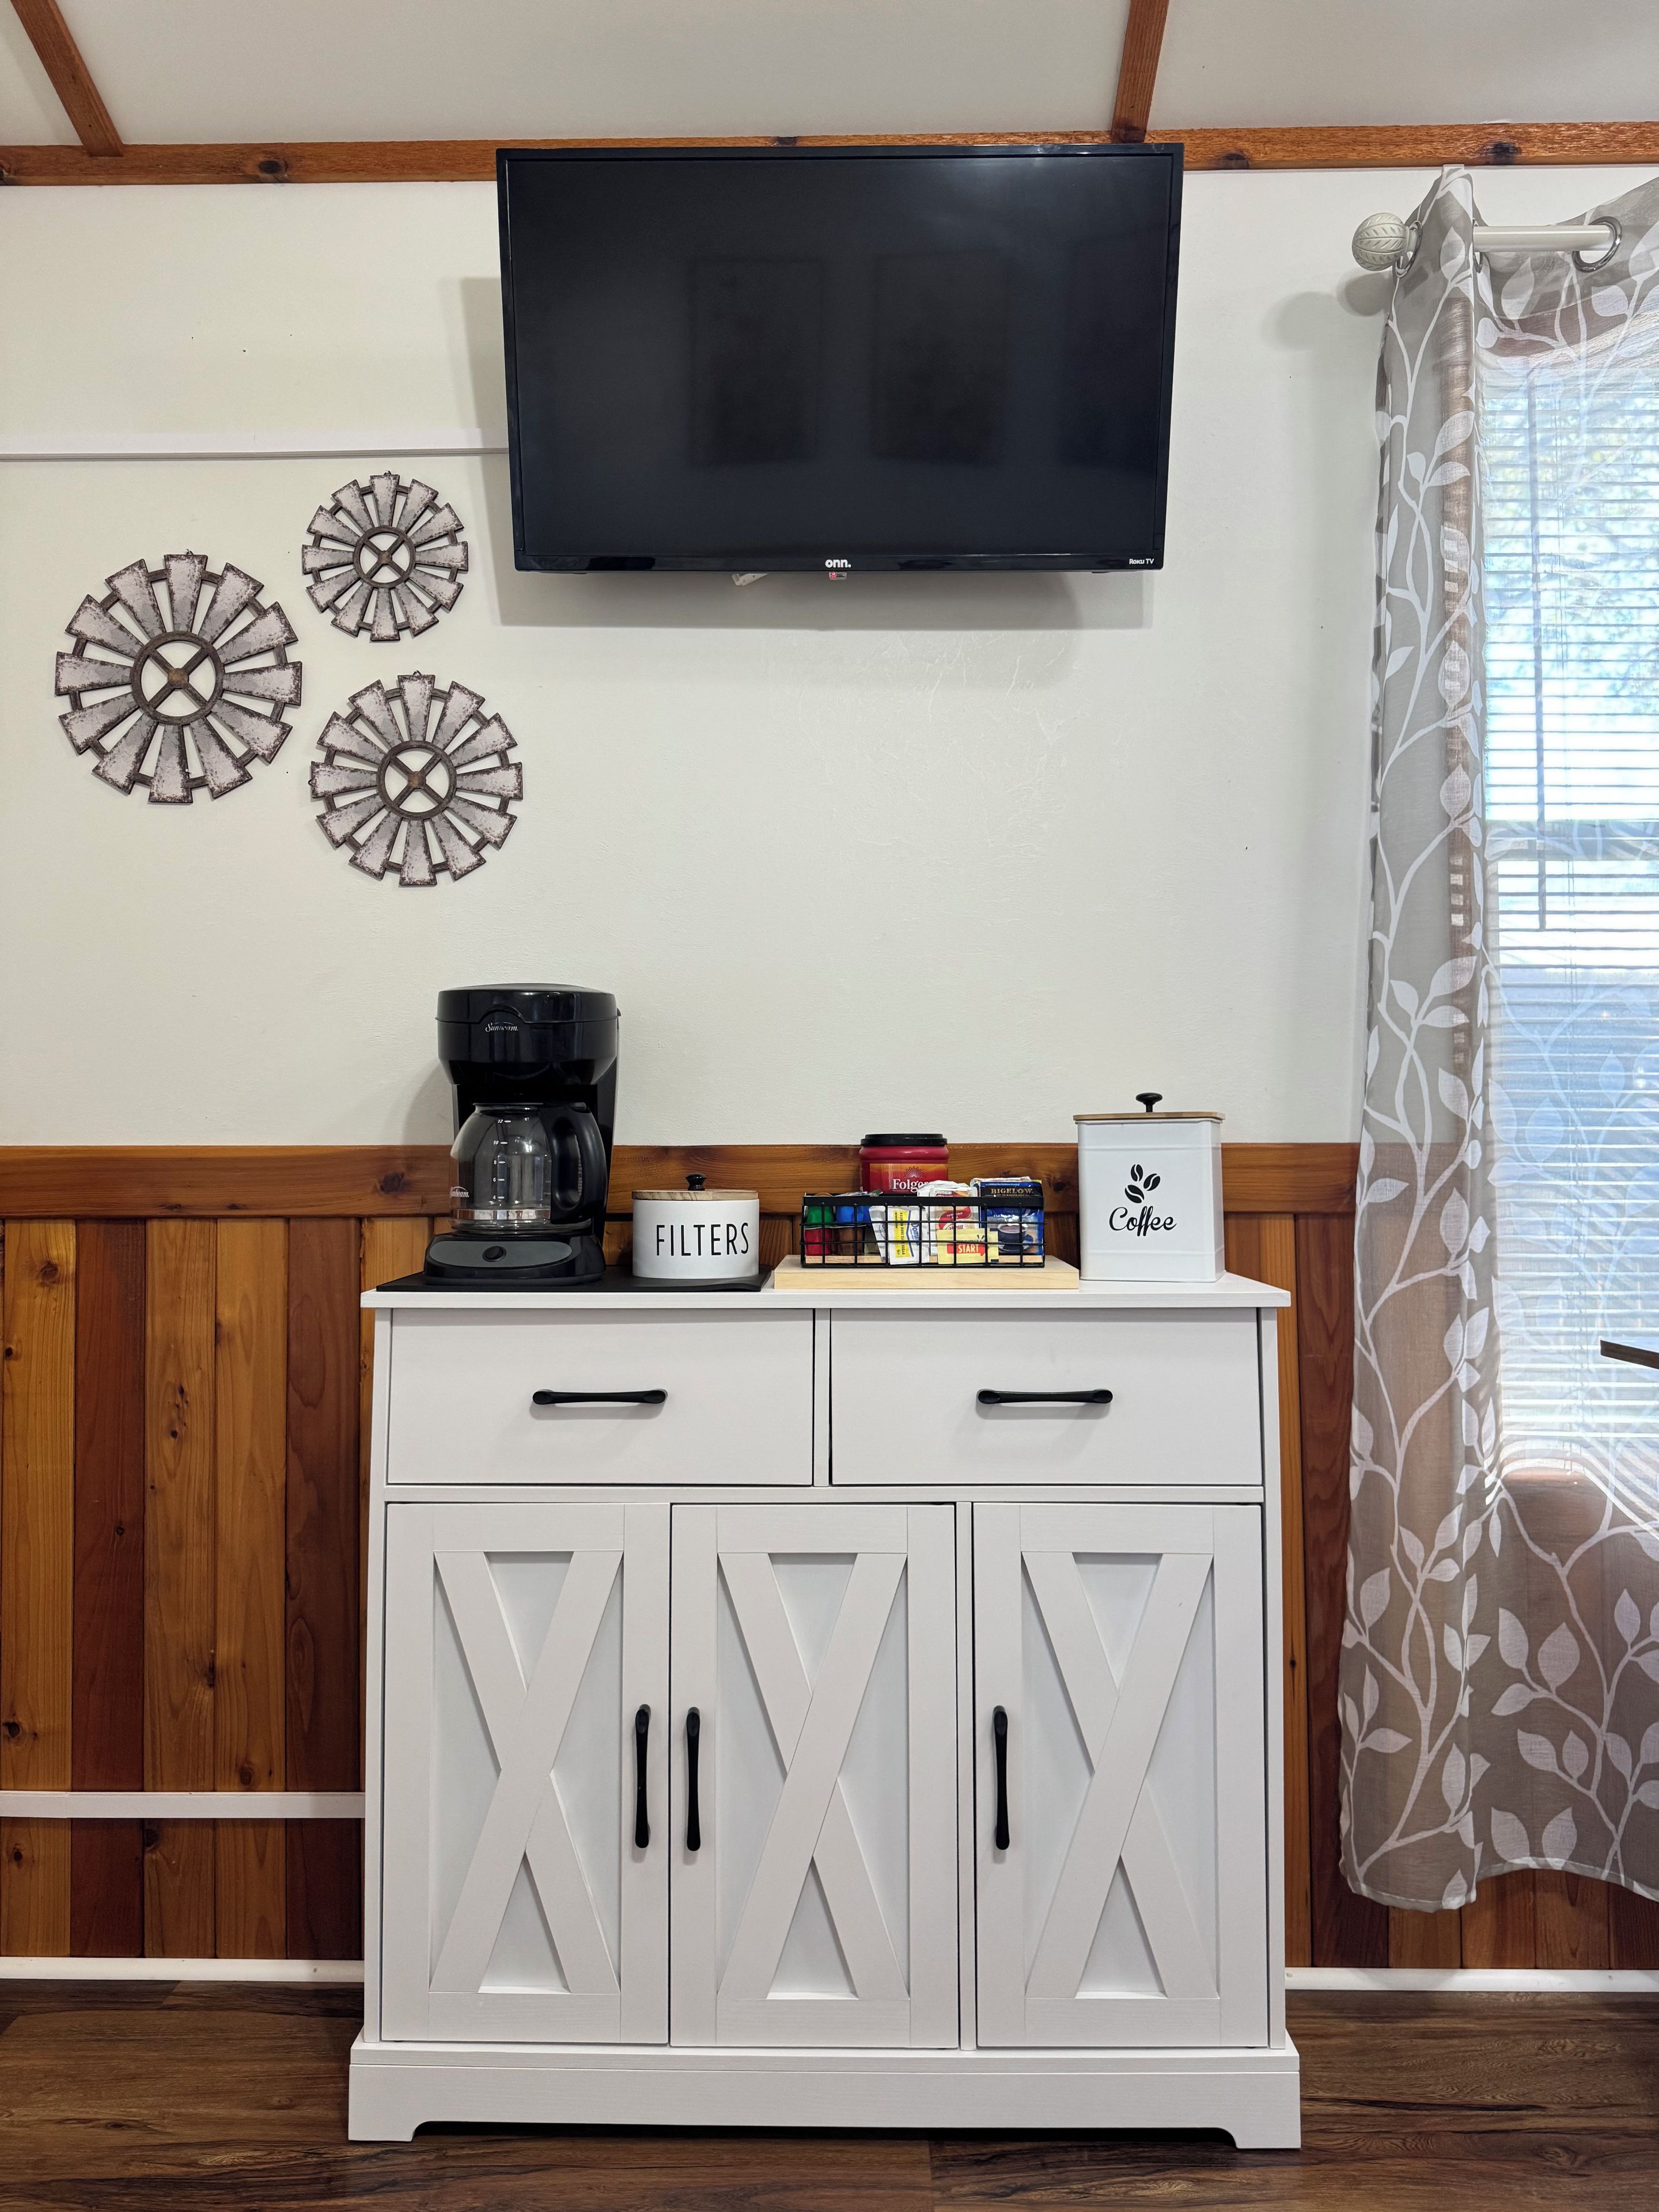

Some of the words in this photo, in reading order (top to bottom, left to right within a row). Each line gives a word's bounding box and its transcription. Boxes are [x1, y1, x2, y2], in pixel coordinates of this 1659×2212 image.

[825, 559, 851, 568] onn.
[892, 1179, 929, 1192] Folge
[1109, 1206, 1177, 1237] Coffee
[656, 1222, 749, 1256] FILTERS
[958, 1244, 979, 1253] START
